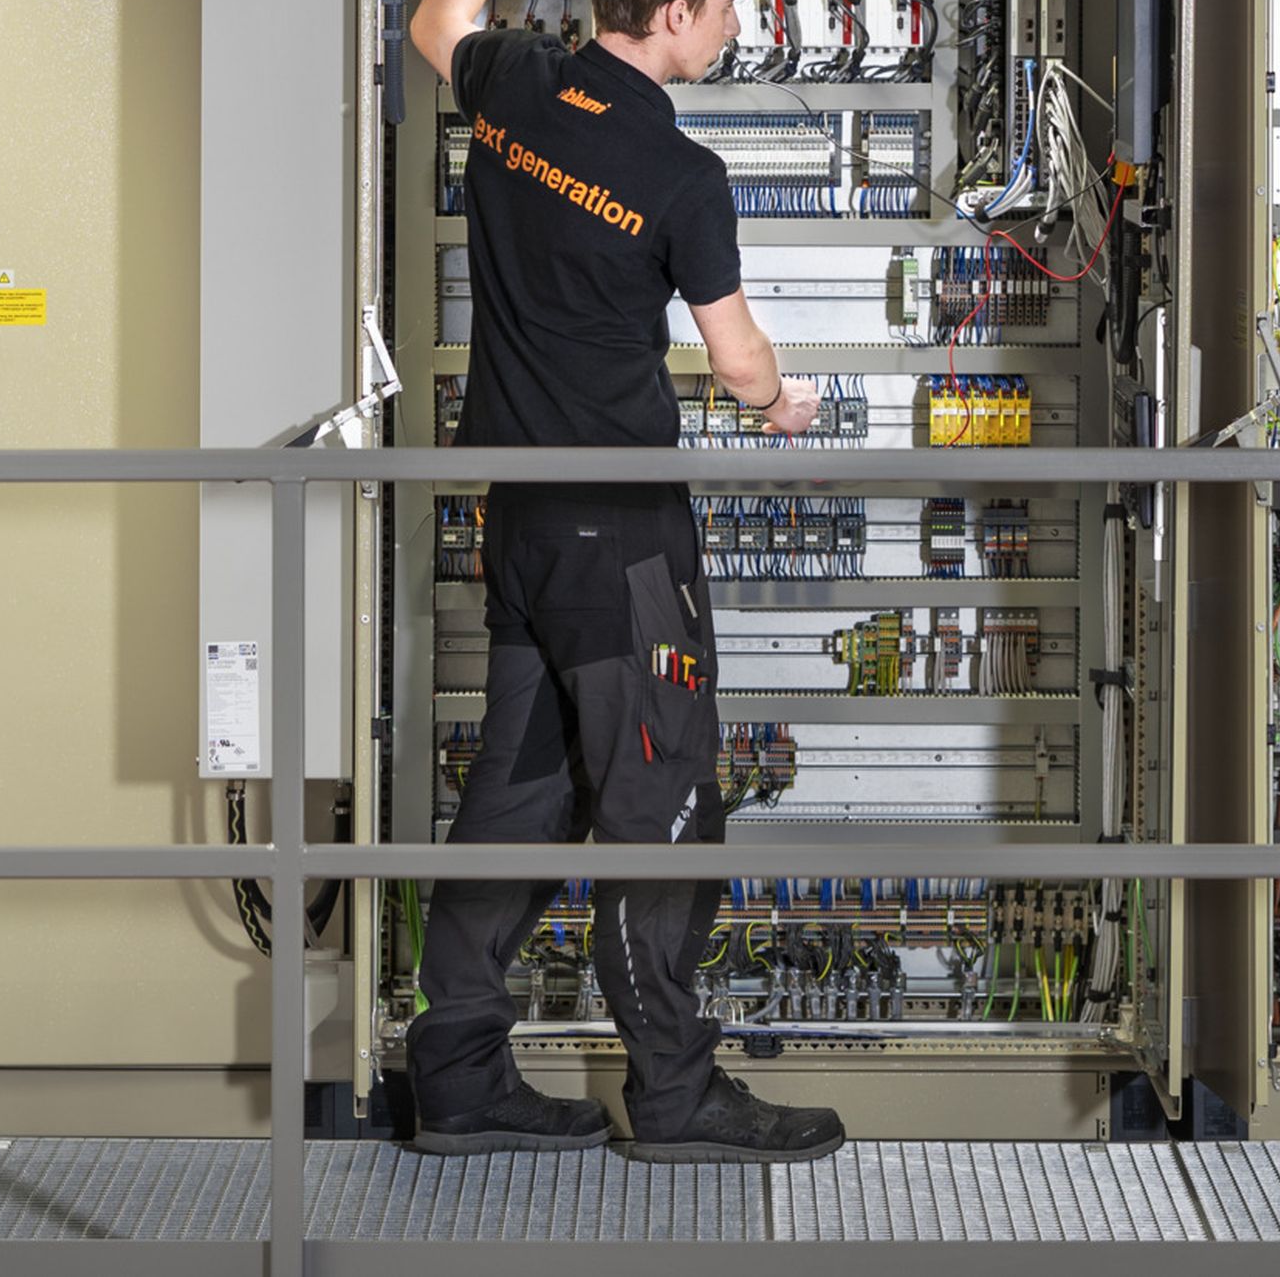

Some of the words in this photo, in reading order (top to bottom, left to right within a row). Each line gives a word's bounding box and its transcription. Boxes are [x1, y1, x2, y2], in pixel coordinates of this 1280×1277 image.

[562, 86, 607, 115] blum
[474, 113, 506, 153] ext
[506, 141, 644, 236] generation
